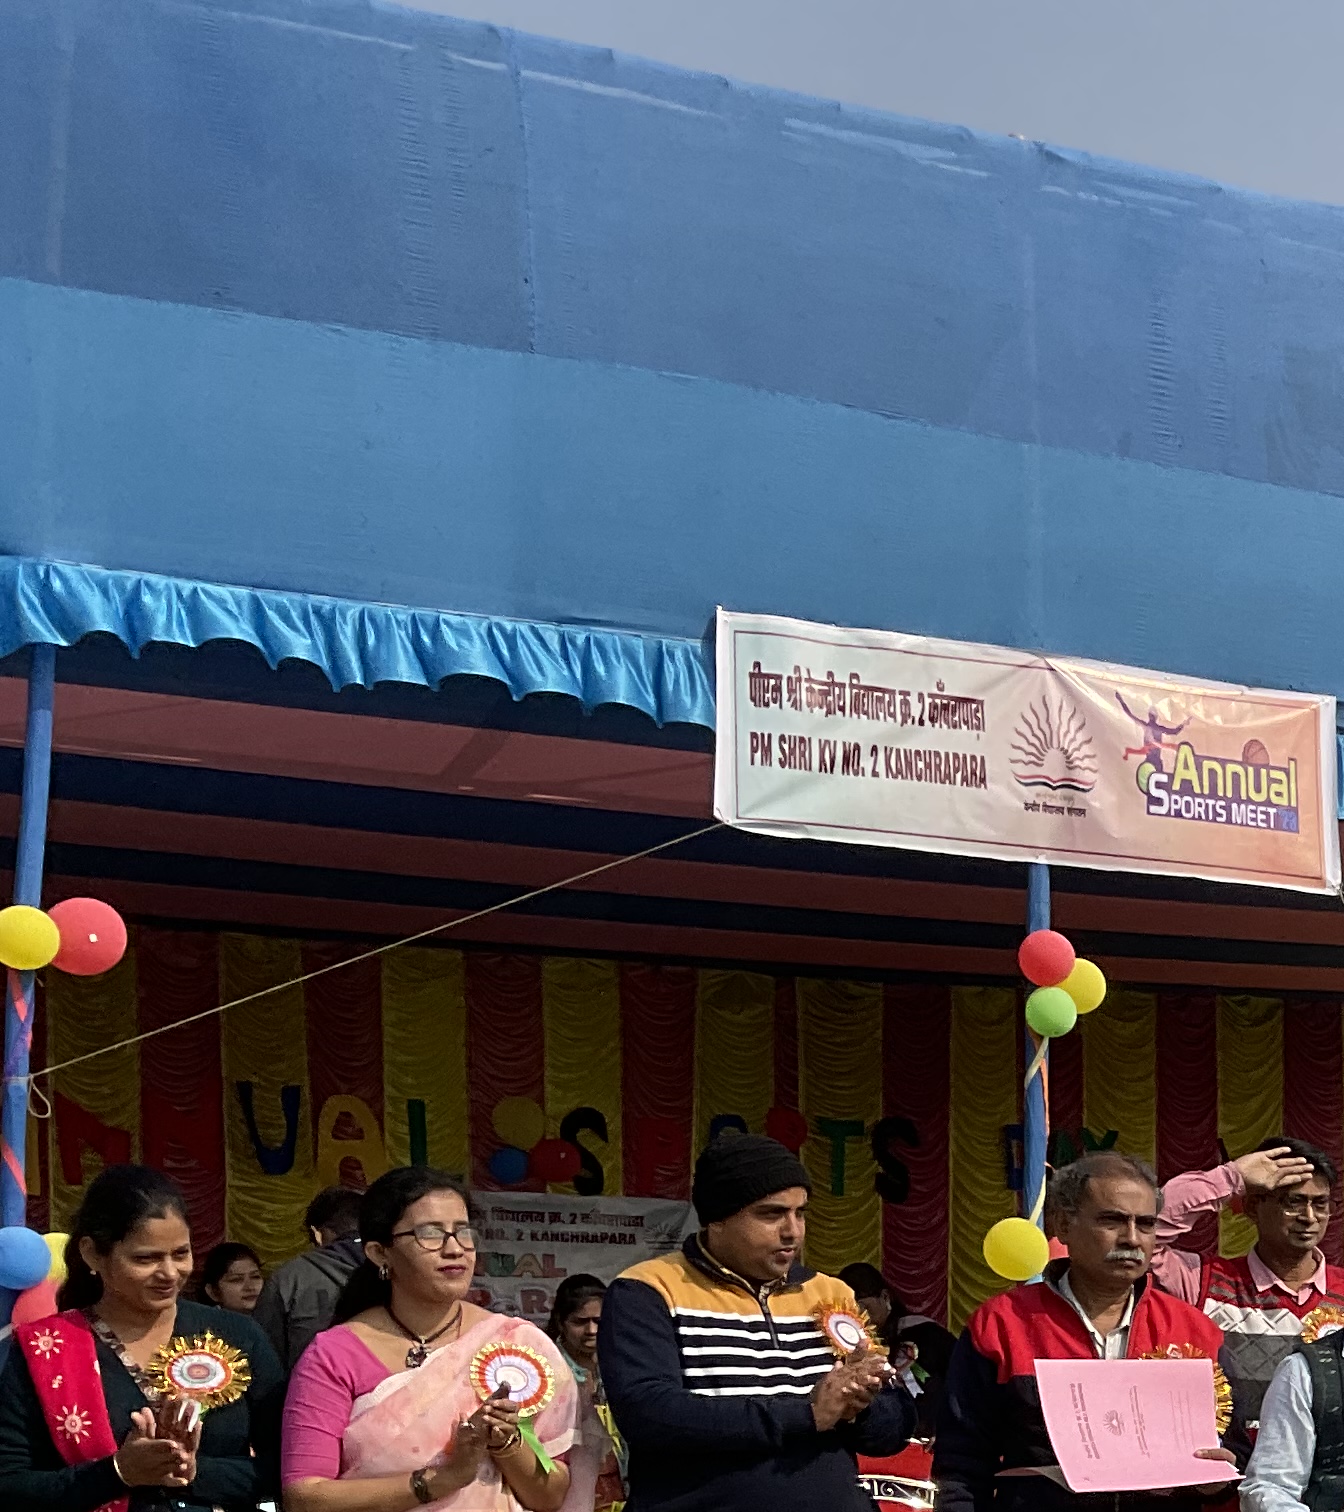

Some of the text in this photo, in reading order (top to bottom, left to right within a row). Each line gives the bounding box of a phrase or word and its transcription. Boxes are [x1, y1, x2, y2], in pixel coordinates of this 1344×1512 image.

[749, 661, 783, 710] पीएम
[786, 665, 803, 712] श्री
[804, 668, 847, 718] केन्द्रीय
[848, 672, 898, 724] विद्यालय
[917, 691, 926, 727] 2
[749, 731, 988, 791] PM SHRI KV NO. 2 KANCHRAPARA
[1172, 743, 1298, 808] Annual
[1231, 802, 1278, 830] MEET
[516, 1228, 525, 1241] 2
[530, 1230, 637, 1245] KANCHRAPARA
